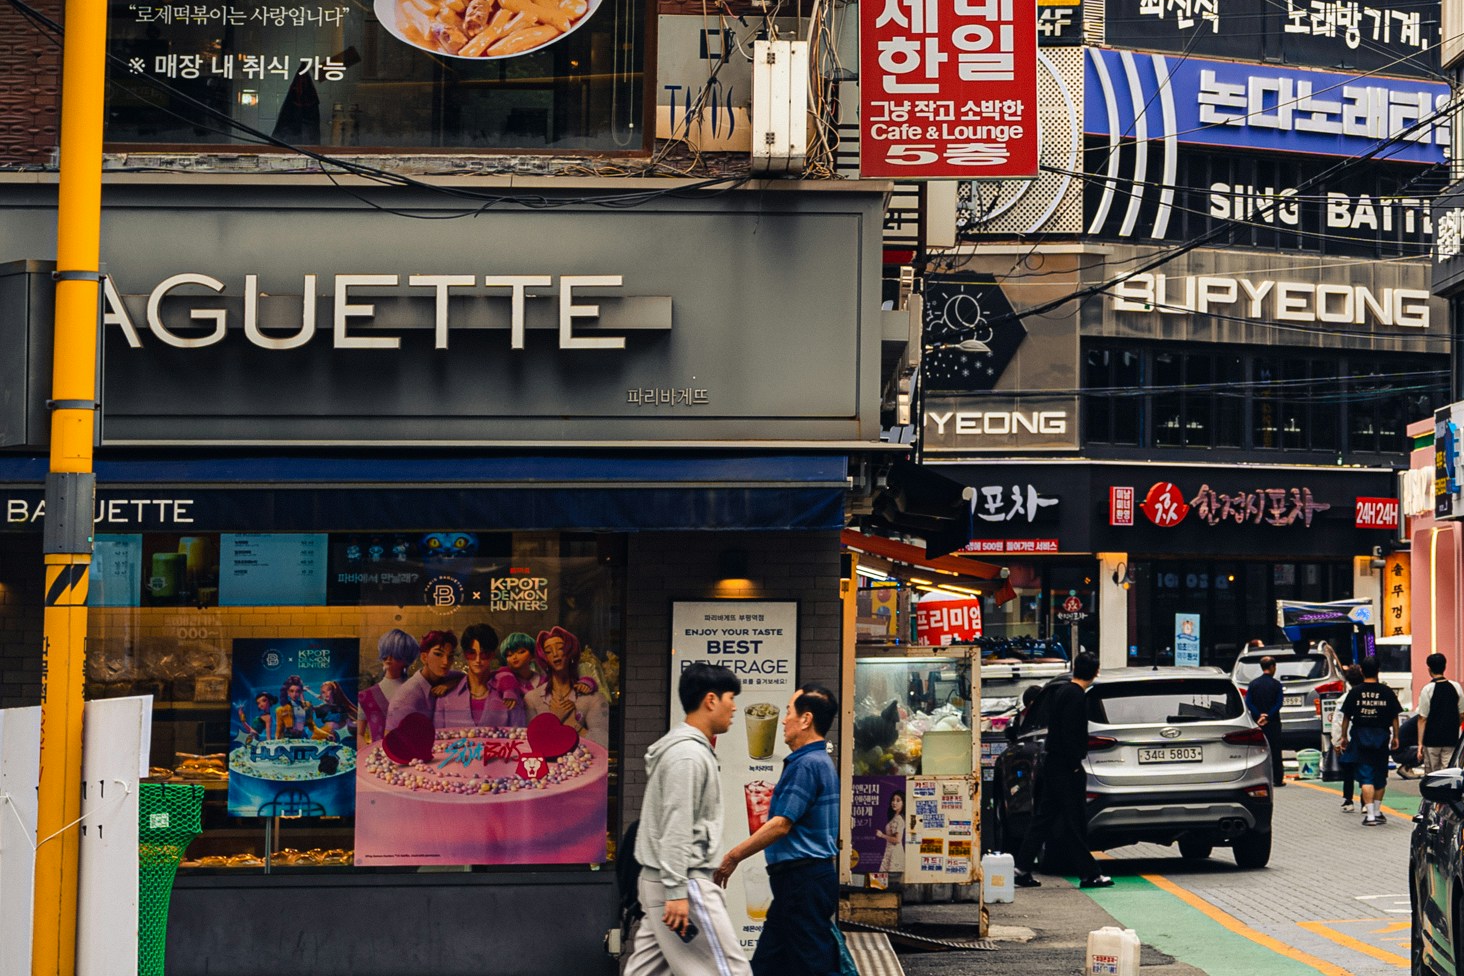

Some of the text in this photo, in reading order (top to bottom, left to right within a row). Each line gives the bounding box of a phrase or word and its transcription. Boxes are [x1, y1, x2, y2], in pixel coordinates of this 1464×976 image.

[154, 54, 347, 82] 매장 내 취식 가능
[870, 99, 1024, 123] 그냥 작고 소박한
[870, 123, 1024, 142] Cafe & Lounge
[884, 142, 1011, 167] 5층
[1210, 181, 1299, 226] SING
[1112, 270, 1431, 328] BUPYEONG
[627, 387, 709, 406] 파리바게뜨
[924, 411, 1067, 436] YEONG
[490, 589, 548, 602] DEMON
[490, 600, 548, 612] HUNTERS
[917, 605, 983, 632] 프리미엄
[685, 628, 783, 636] ENJOY YOUR TASTE
[706, 640, 763, 655] BEST
[1169, 748, 1198, 761] 5803
